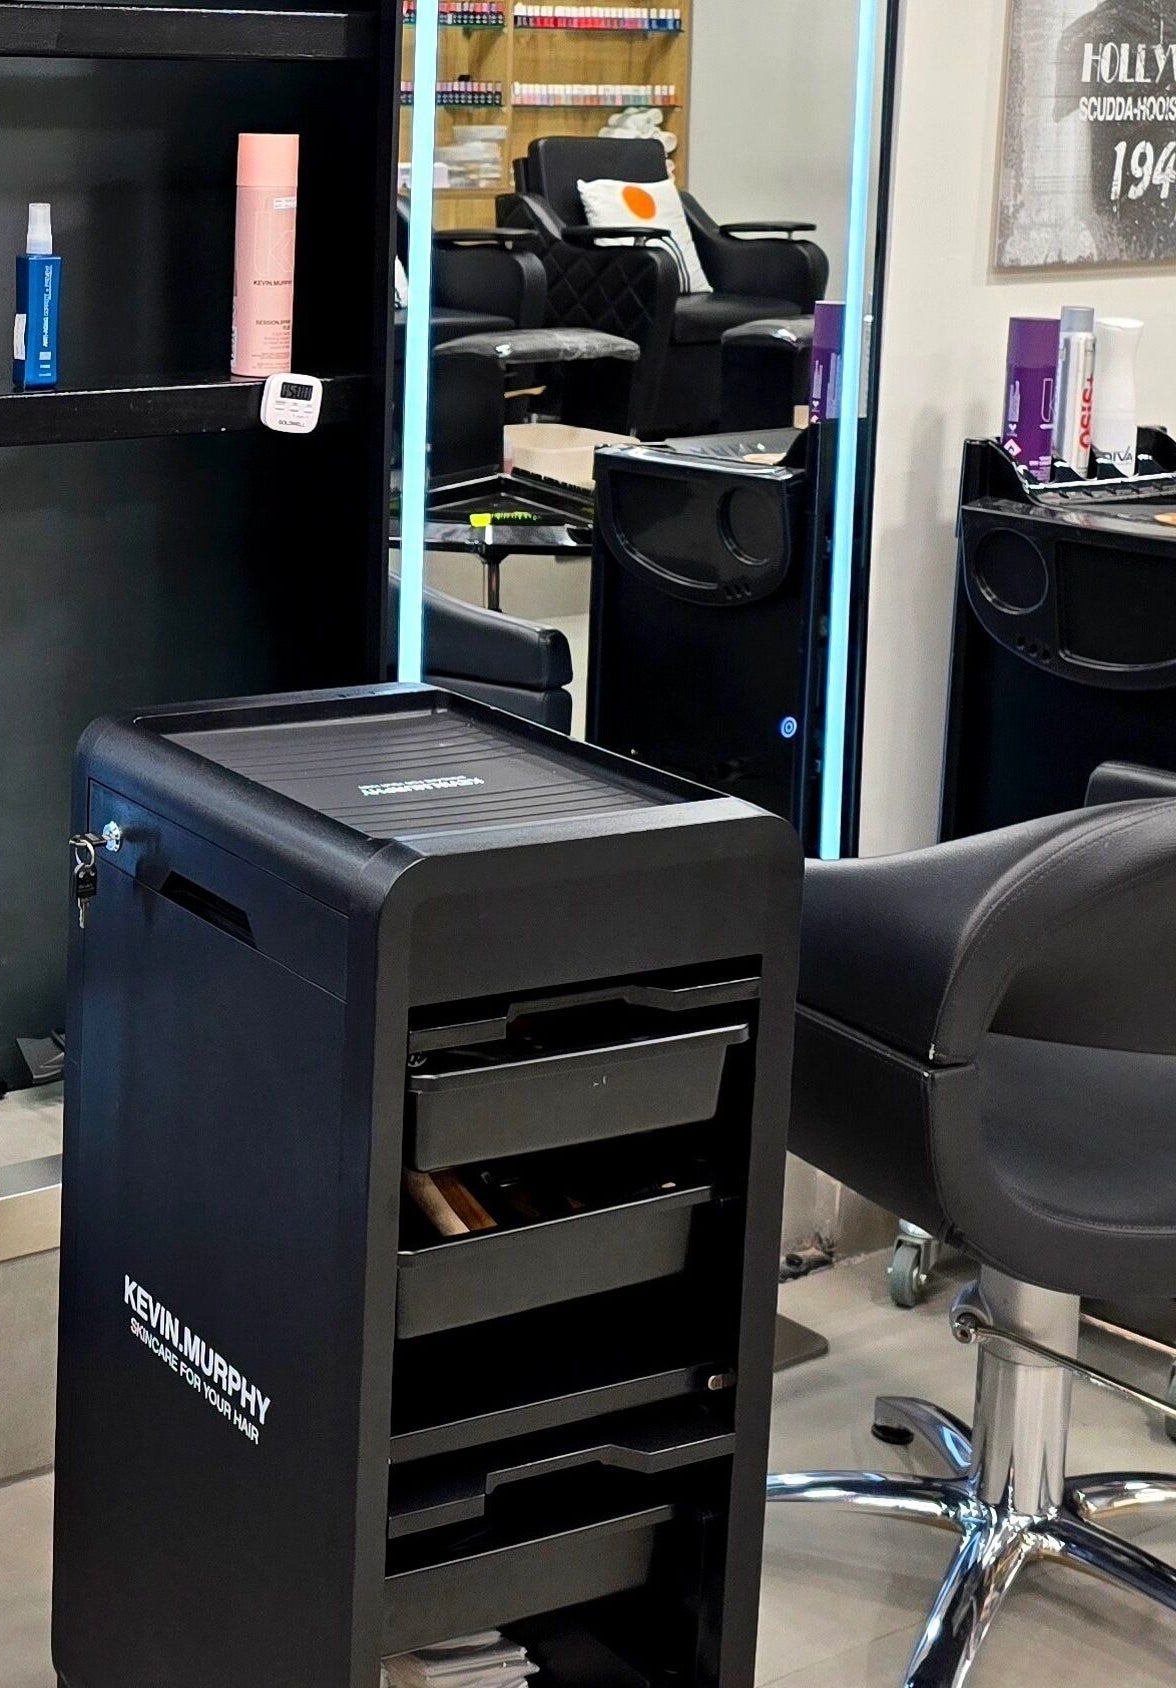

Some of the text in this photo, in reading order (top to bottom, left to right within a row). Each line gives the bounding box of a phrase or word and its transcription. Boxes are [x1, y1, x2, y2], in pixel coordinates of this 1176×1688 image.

[124, 1274, 271, 1425] KEVIN.MURPHY
[130, 1317, 259, 1445] SKINCARE FOR YOUR HAIR
